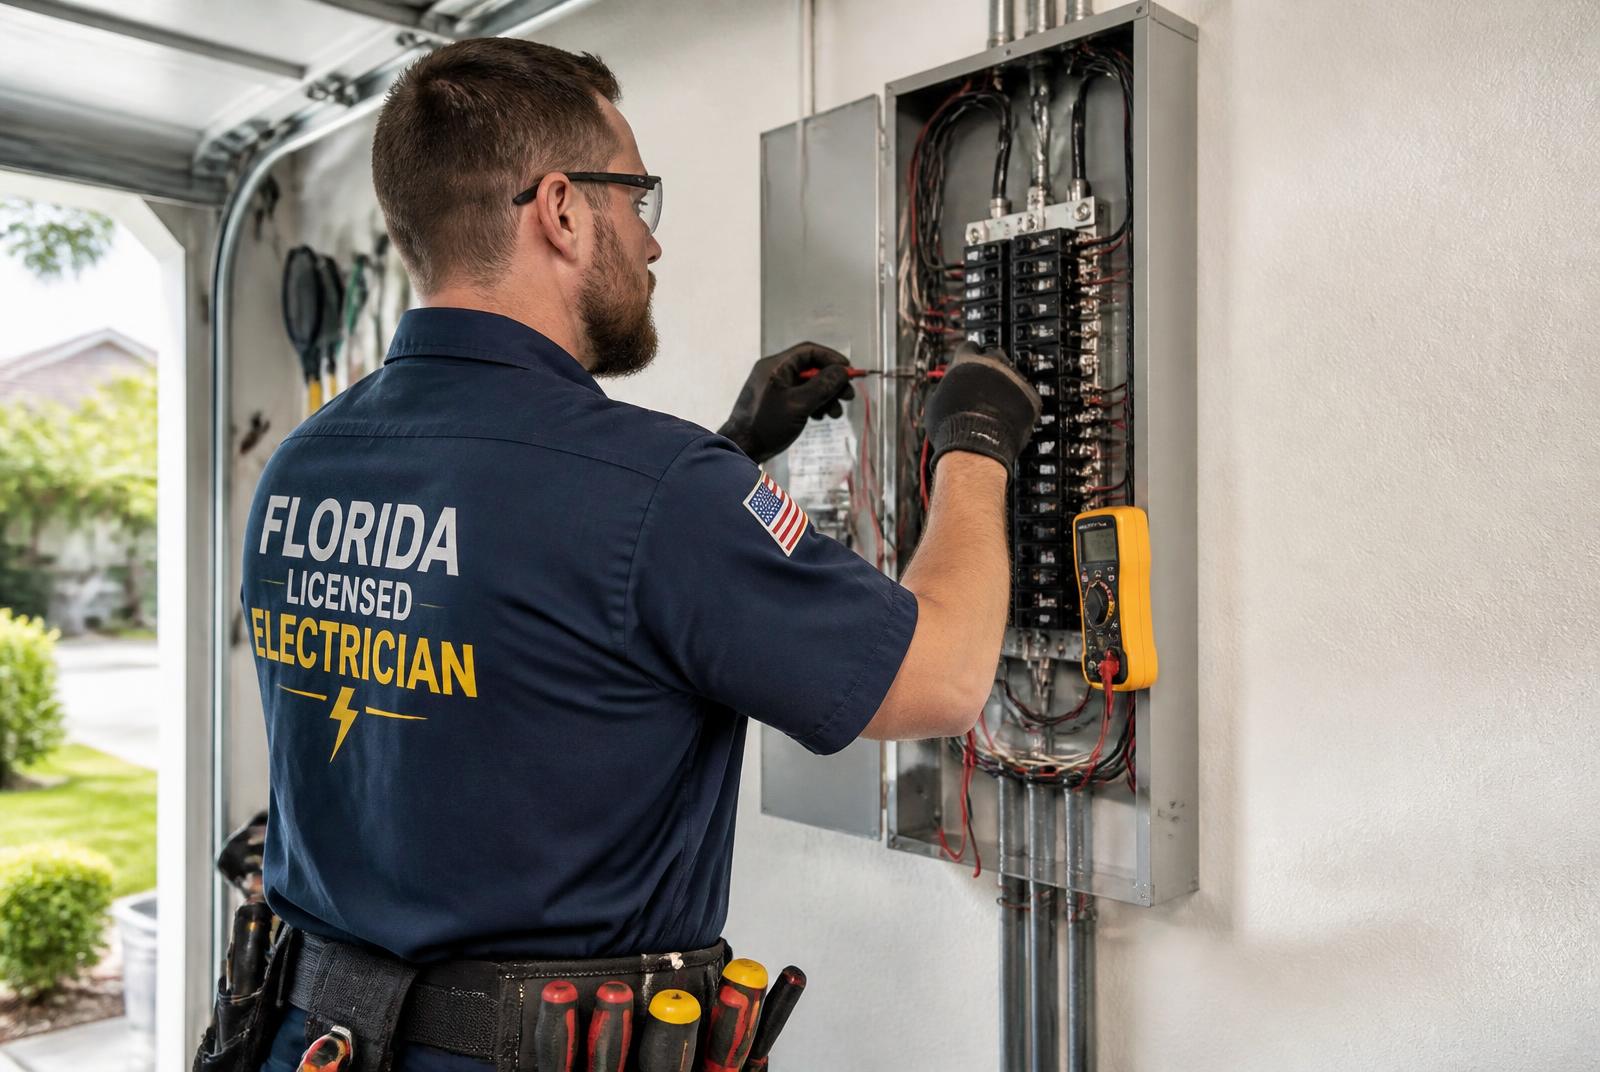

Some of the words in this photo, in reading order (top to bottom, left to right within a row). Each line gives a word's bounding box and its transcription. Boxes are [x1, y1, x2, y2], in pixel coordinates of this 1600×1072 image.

[259, 495, 459, 576] FLORIDA
[286, 568, 412, 621] LICENSED
[251, 608, 477, 697] ELECTRICIAN
